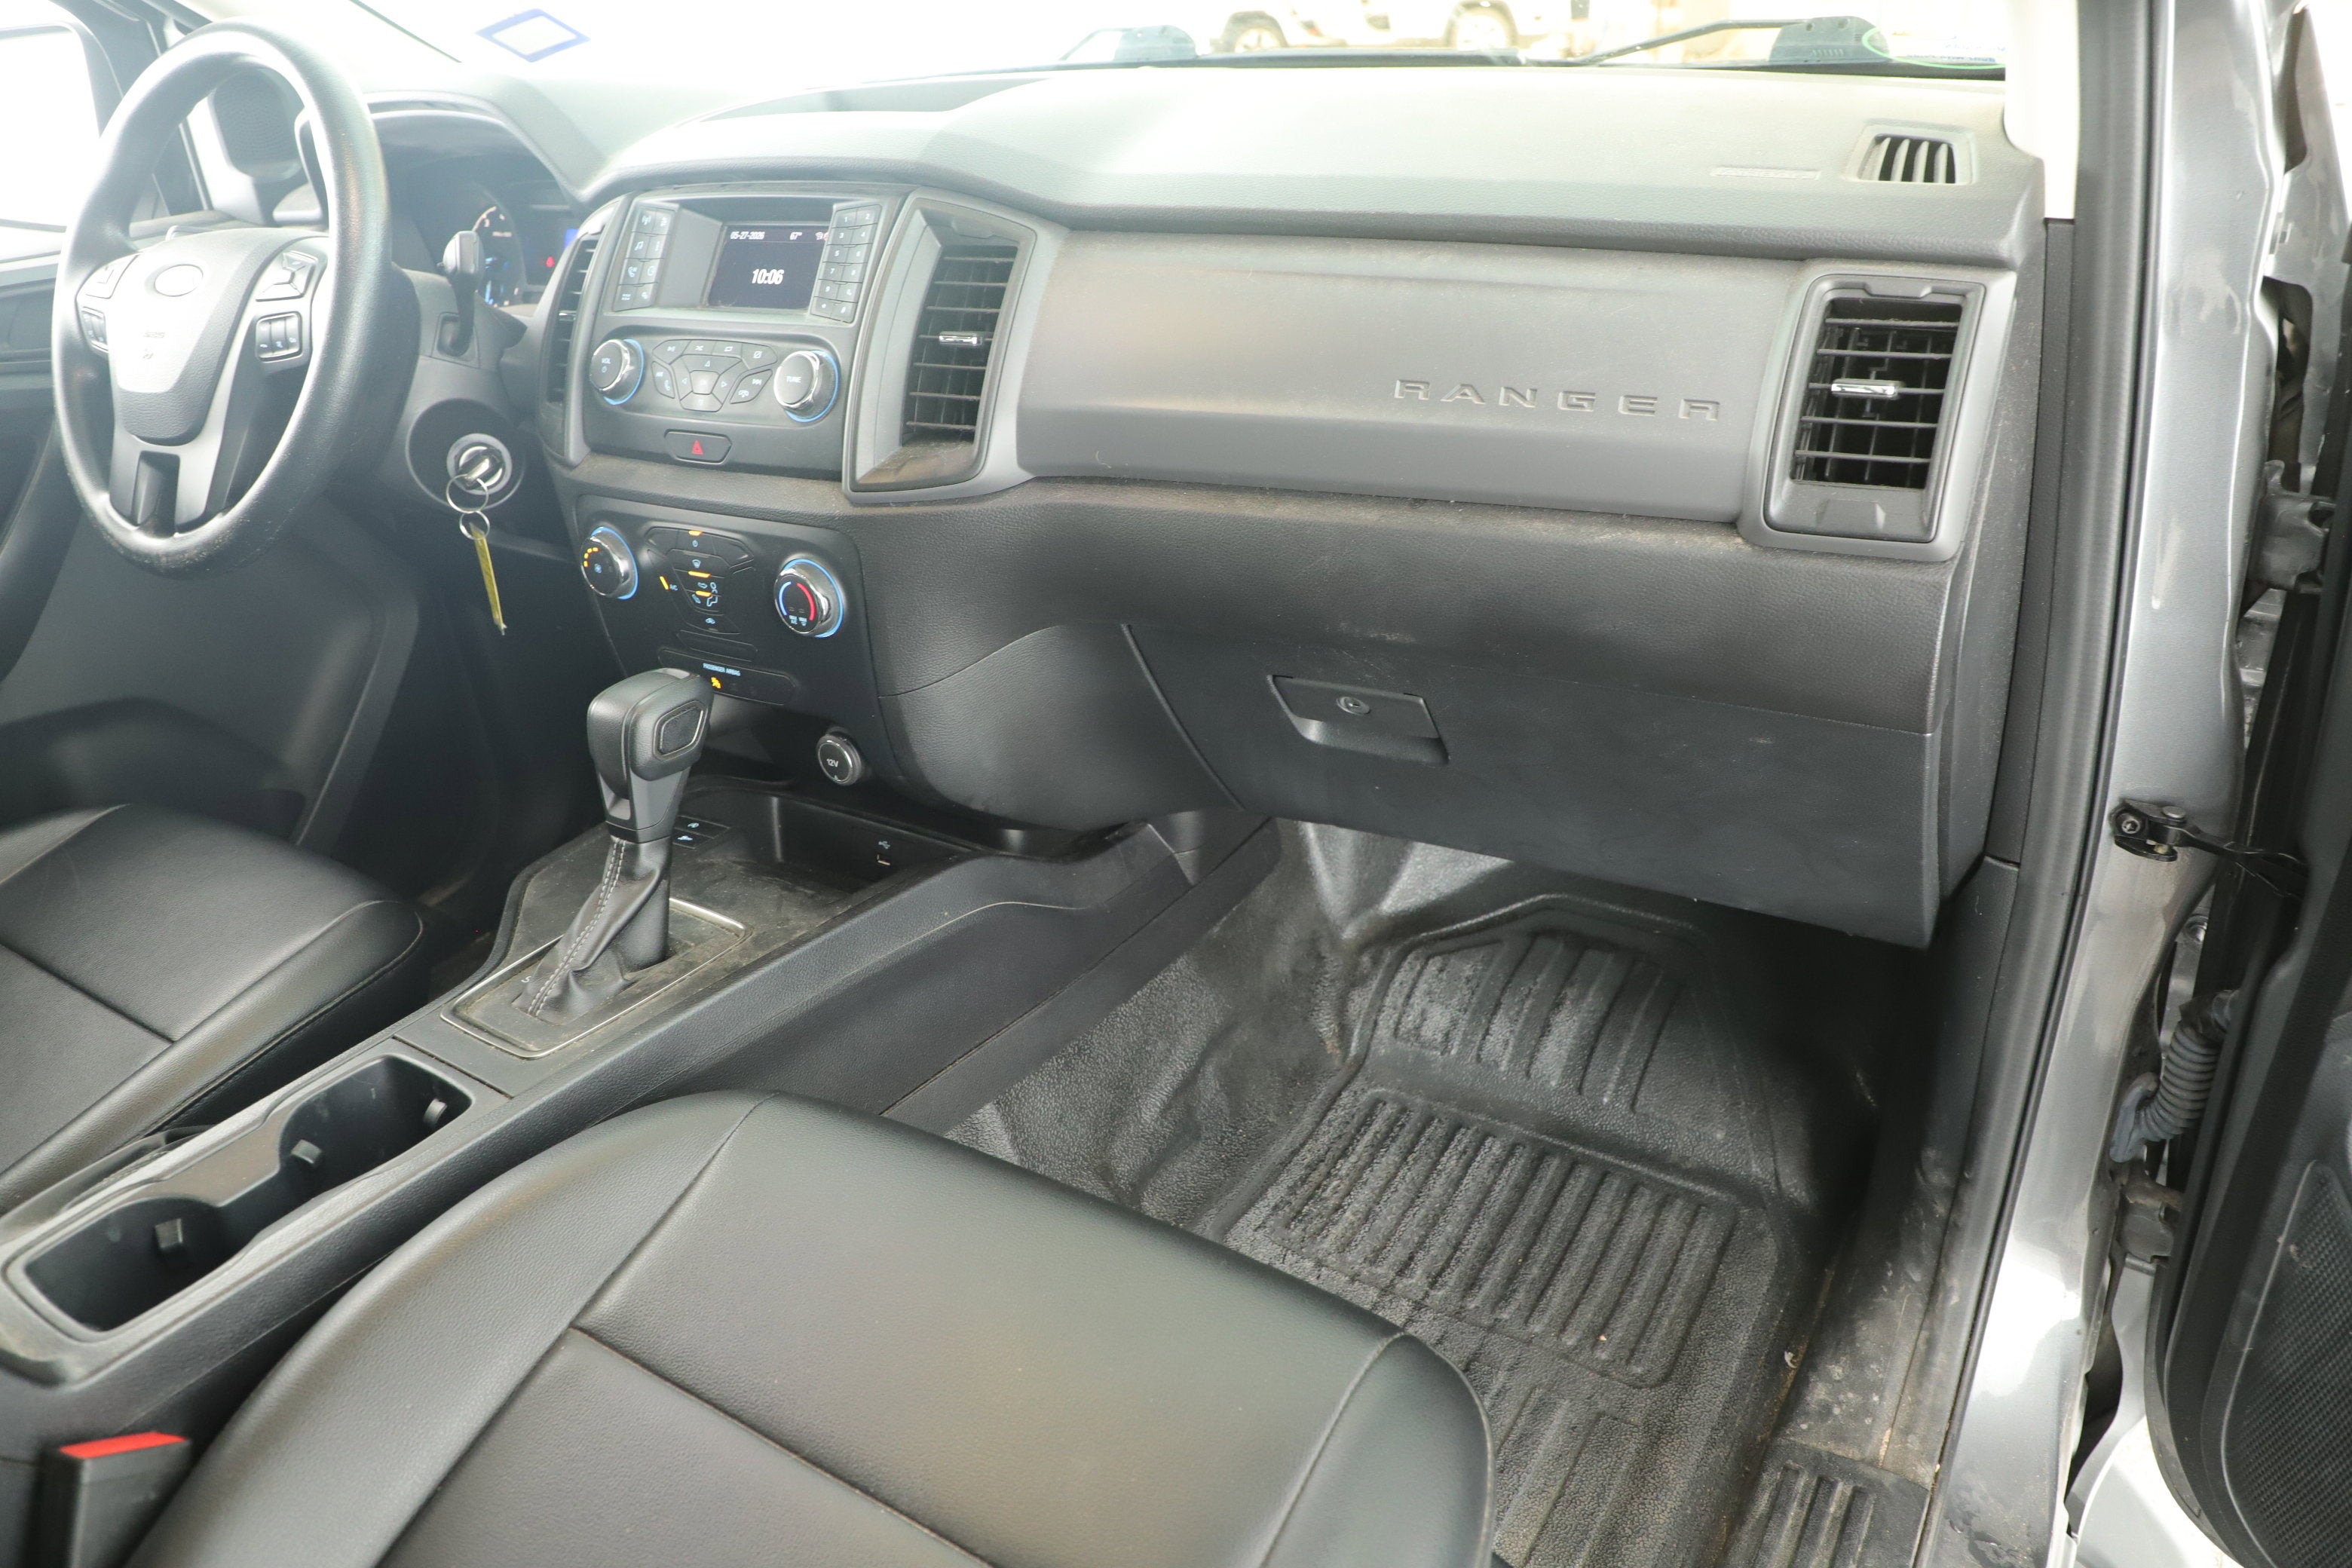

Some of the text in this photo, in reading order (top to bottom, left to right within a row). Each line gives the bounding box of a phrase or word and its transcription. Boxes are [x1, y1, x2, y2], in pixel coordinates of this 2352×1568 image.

[752, 268, 784, 285] 10:06
[1394, 379, 1720, 421] RANGER
[703, 663, 741, 676] PASSENGER AIRBAG
[826, 758, 838, 767] 12V
